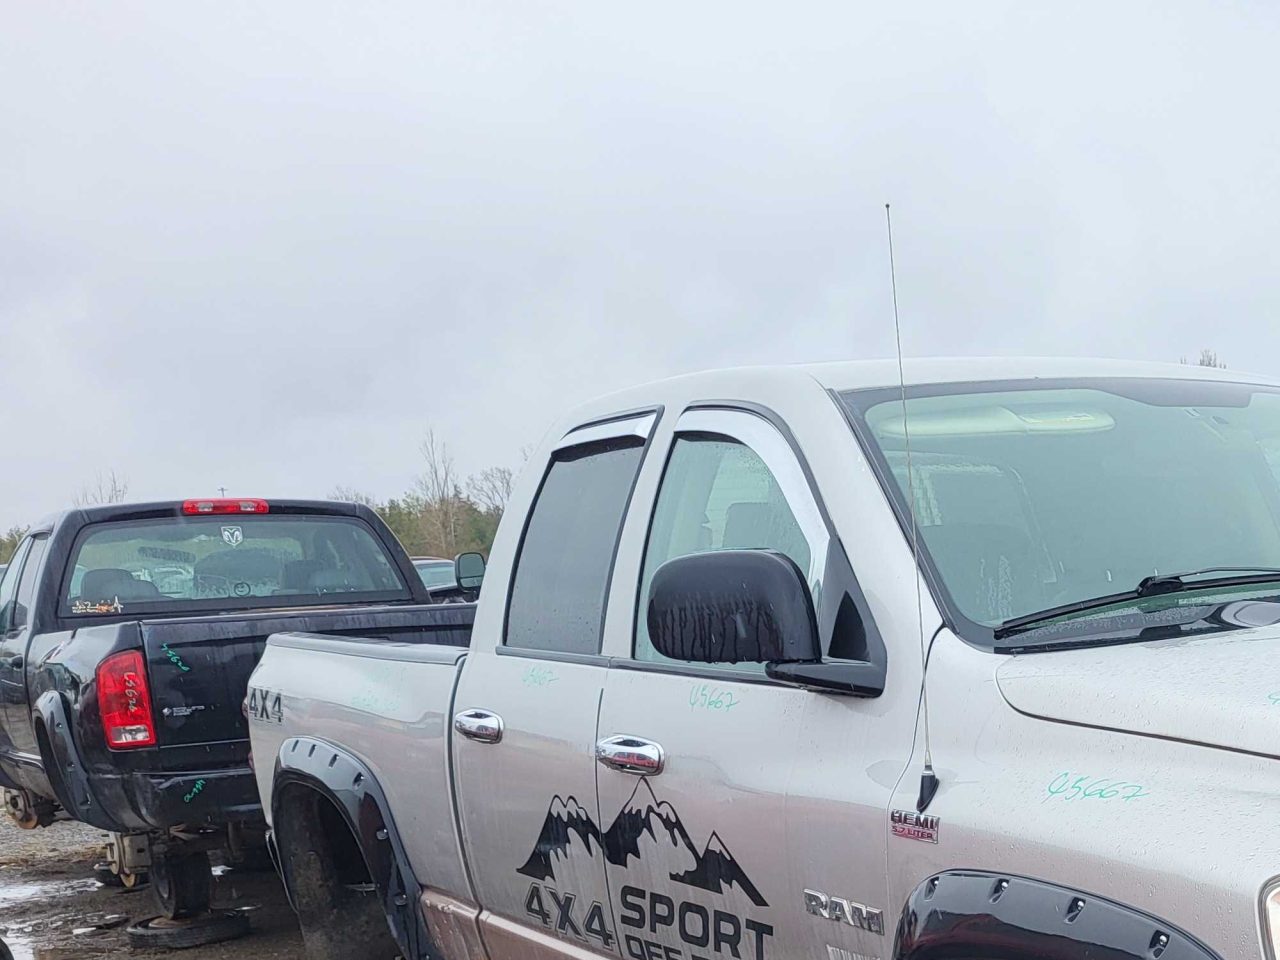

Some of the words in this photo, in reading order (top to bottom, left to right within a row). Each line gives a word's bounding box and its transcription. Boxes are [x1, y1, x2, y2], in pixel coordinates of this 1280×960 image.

[249, 688, 285, 724] 4X4
[1041, 771, 1151, 804] 45667
[891, 810, 936, 830] HEMI
[907, 828, 934, 840] LITER
[524, 881, 618, 954] 4X4
[803, 888, 886, 936] RAM
